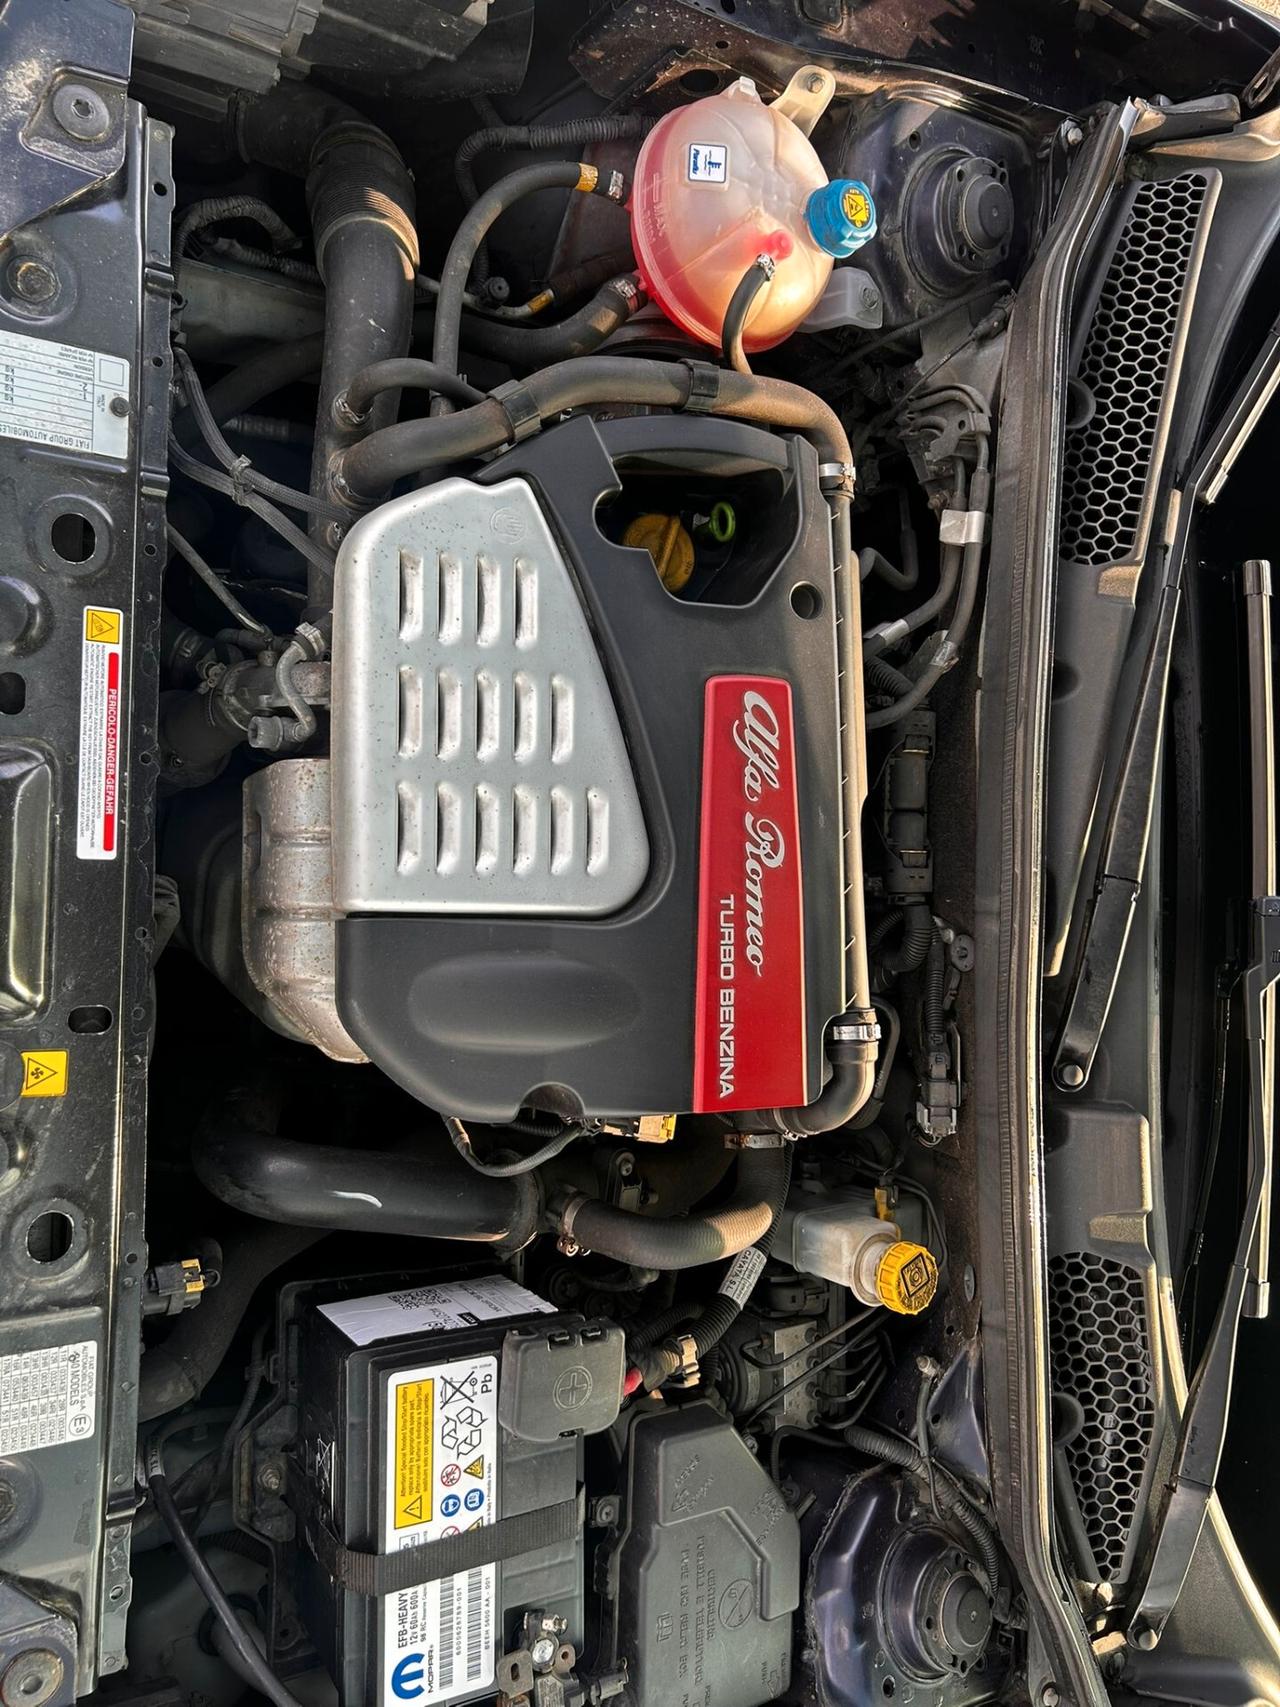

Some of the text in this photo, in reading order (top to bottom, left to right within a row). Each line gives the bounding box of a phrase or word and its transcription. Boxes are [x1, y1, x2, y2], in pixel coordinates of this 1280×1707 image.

[692, 148, 700, 174] Paraflu
[49, 435, 73, 445] GROUP
[75, 440, 90, 448] FIAT
[106, 688, 116, 814] PERICOLO-DANGER-GEFAHR
[732, 691, 786, 976] Alfa Romeo
[719, 894, 736, 1098] TURBO BENZINA
[70, 1370, 80, 1406] MODELS
[480, 1374, 492, 1394] Pb
[398, 1593, 407, 1648] EFB-HEAVY
[706, 1569, 715, 1641] CENTRALINA
